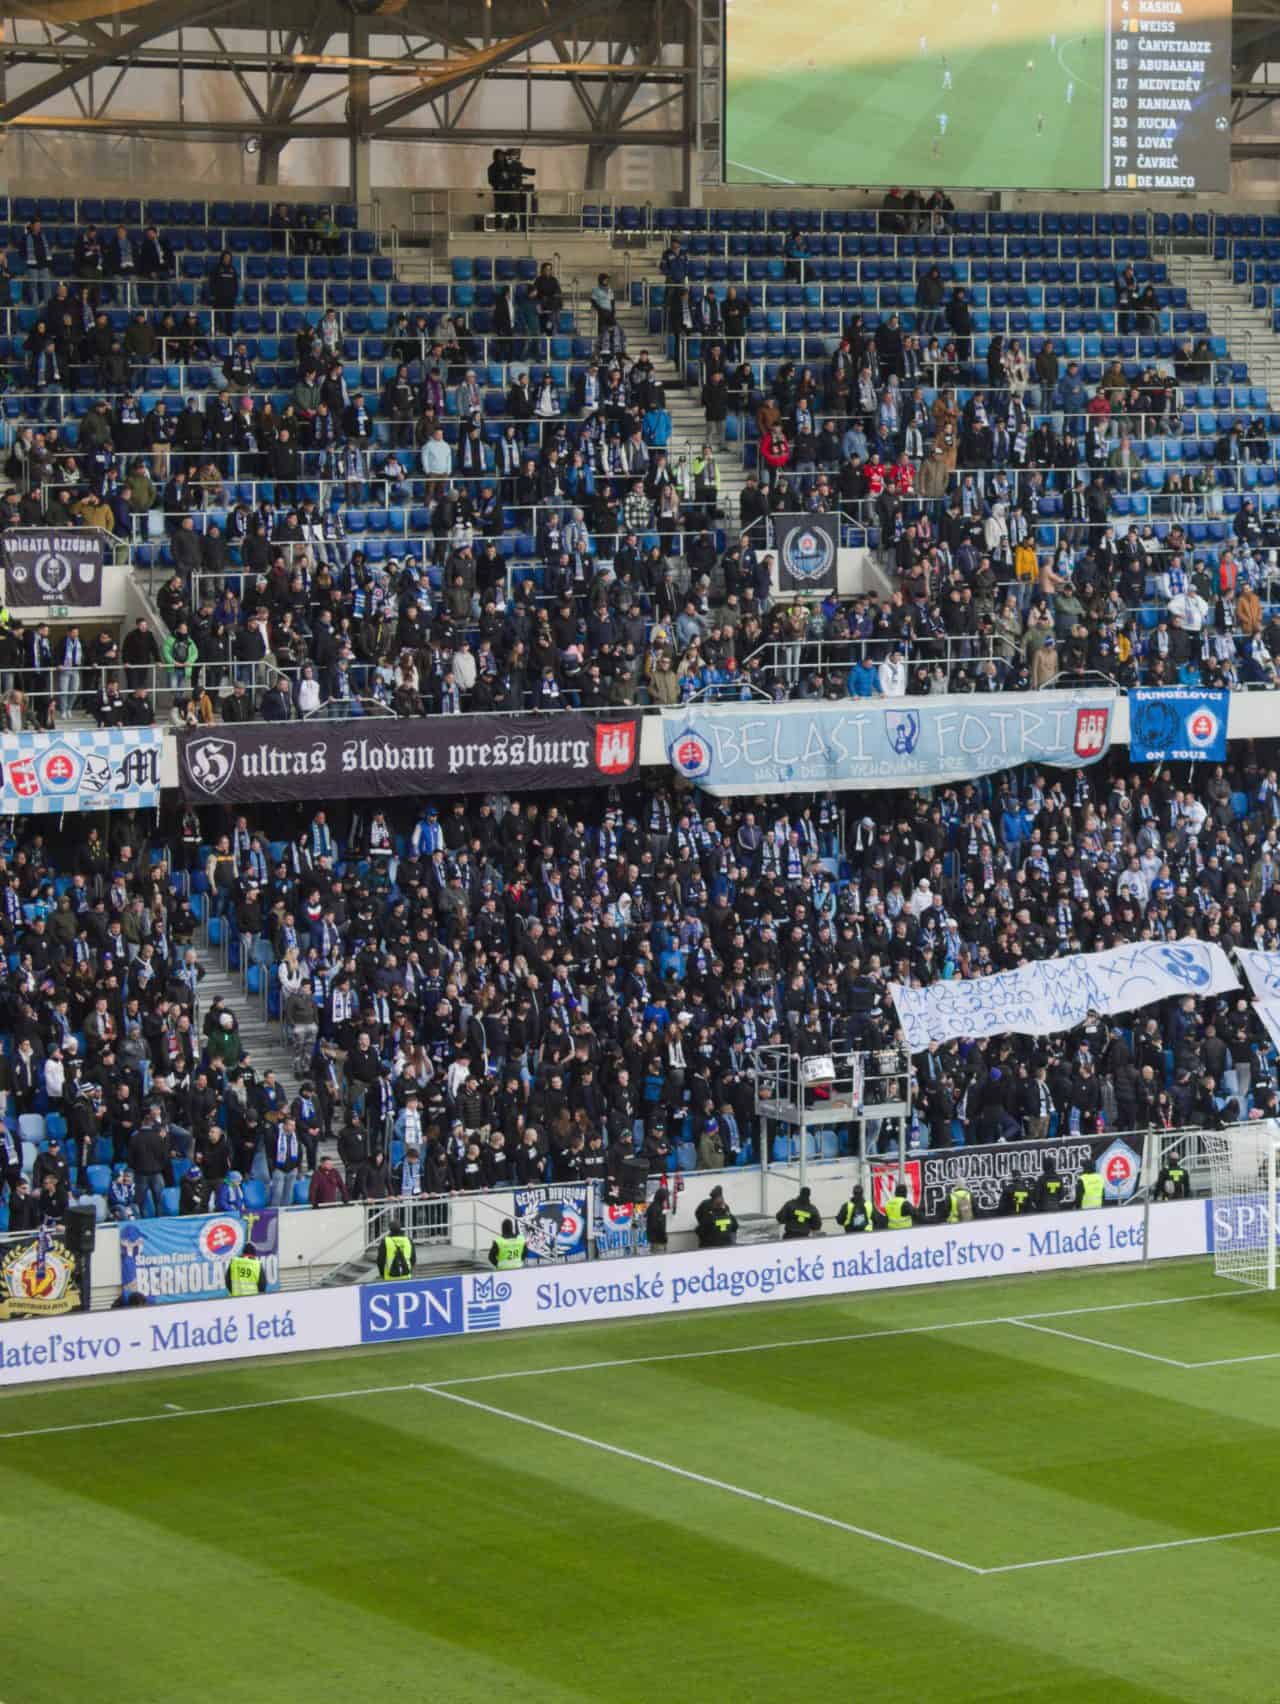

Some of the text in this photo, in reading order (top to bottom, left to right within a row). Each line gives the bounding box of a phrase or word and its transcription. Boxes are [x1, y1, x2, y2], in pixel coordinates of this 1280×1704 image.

[1121, 20, 1176, 33] 7 WEISS
[1115, 39, 1129, 51] 10
[1115, 58, 1206, 72] 15 ABUBAKARI
[1116, 77, 1129, 90] 17
[1112, 97, 1192, 111] 20 KANKAVA
[1112, 117, 1177, 129] 33 KUCKA
[1112, 136, 1174, 149] 36 LOVAT
[1113, 156, 1128, 168] 77
[1137, 175, 1153, 187] DE
[1154, 175, 1195, 188] MARCO
[933, 708, 1071, 756] FOTRI
[241, 734, 590, 777] ultras slovan pressburg
[1145, 750, 1208, 760] ON TOUR
[536, 1272, 665, 1312] Slovenské
[671, 1256, 825, 1304] pedagogické
[832, 1238, 1005, 1280] nakladateľstvo
[1028, 1225, 1102, 1259] Mladé
[1108, 1220, 1147, 1249] letá
[368, 1287, 455, 1333] SPN
[149, 1318, 239, 1353] Mladé
[247, 1309, 297, 1345] letá
